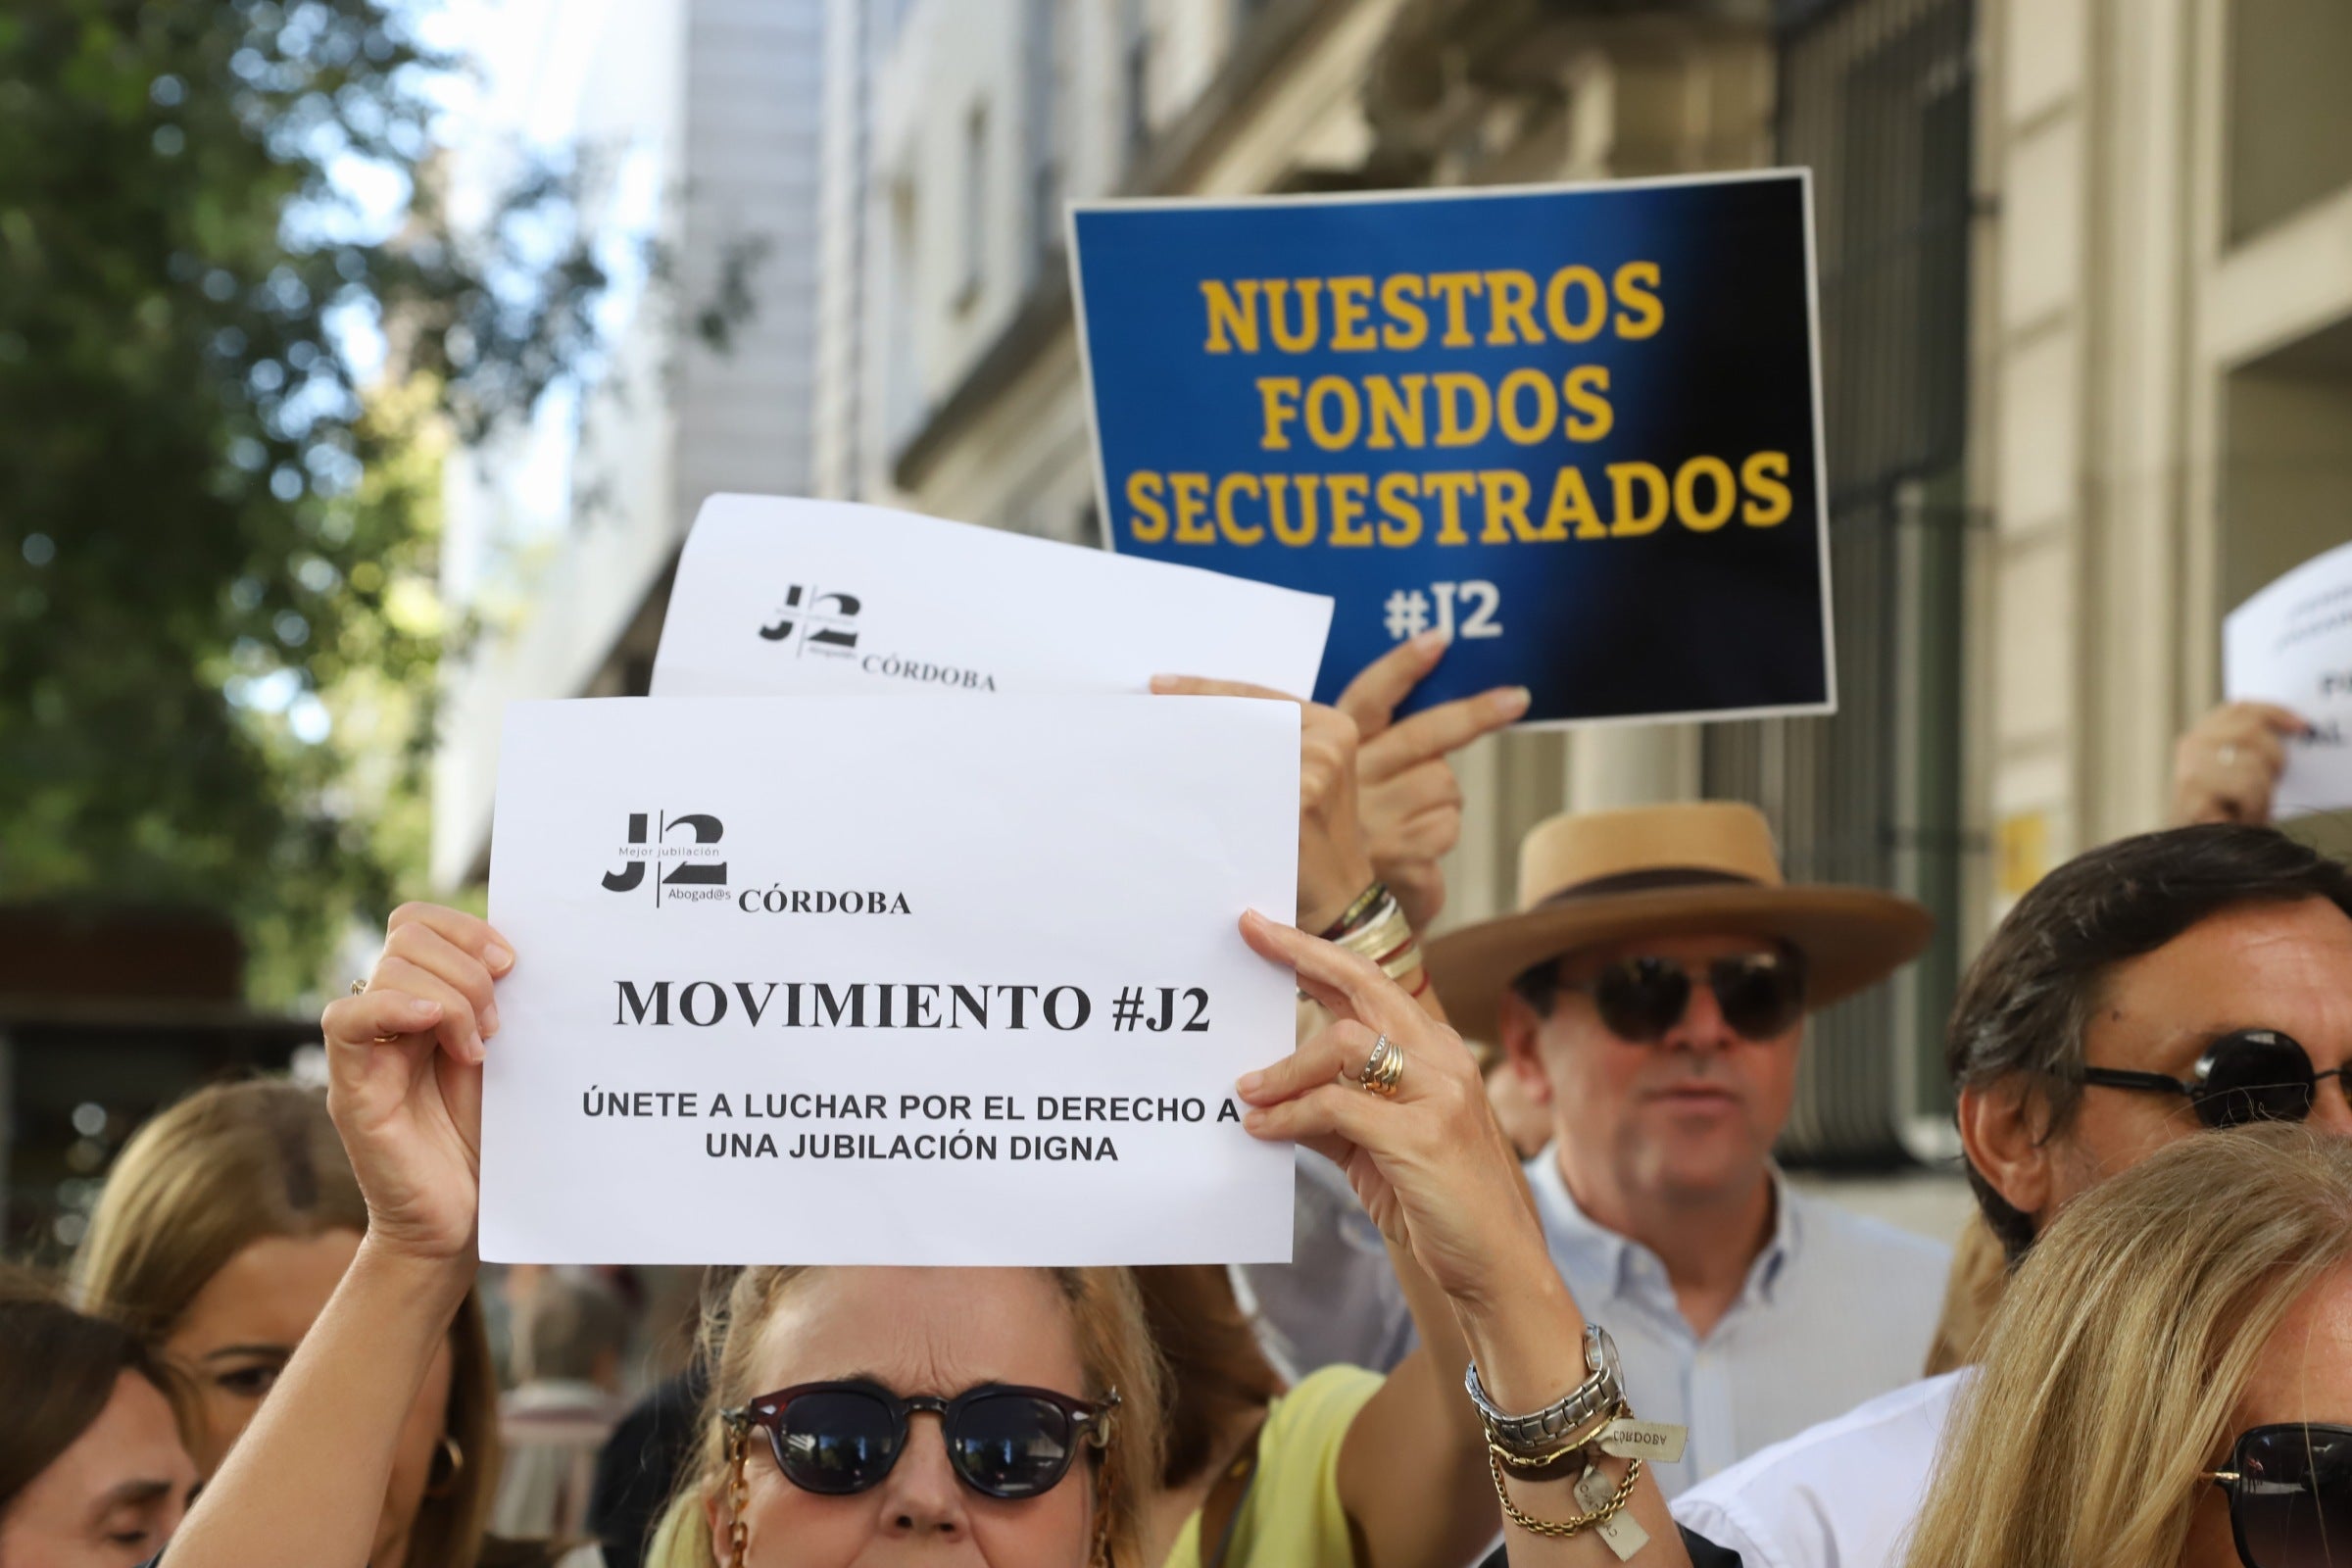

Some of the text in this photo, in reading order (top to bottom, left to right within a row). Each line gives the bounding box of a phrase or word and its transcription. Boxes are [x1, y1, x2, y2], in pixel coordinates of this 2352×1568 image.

[1200, 262, 1665, 354] NUESTROS
[1256, 366, 1614, 451] FONDOS
[1126, 451, 1792, 547] SECUESTRADOS
[1384, 579, 1503, 646] #J2
[861, 653, 997, 693] CÓRDOBA
[618, 846, 720, 858] Mejor jubilación
[667, 887, 732, 903] Abogad@s
[738, 882, 912, 915] CÓRDOBA
[612, 981, 1211, 1033] MOVIMIENTO #J2
[583, 1085, 1241, 1123] ÚNETE A LUCHAR POR EL DERECHO A
[706, 1128, 1119, 1161] UNA JUBILACIÓN DIGNA
